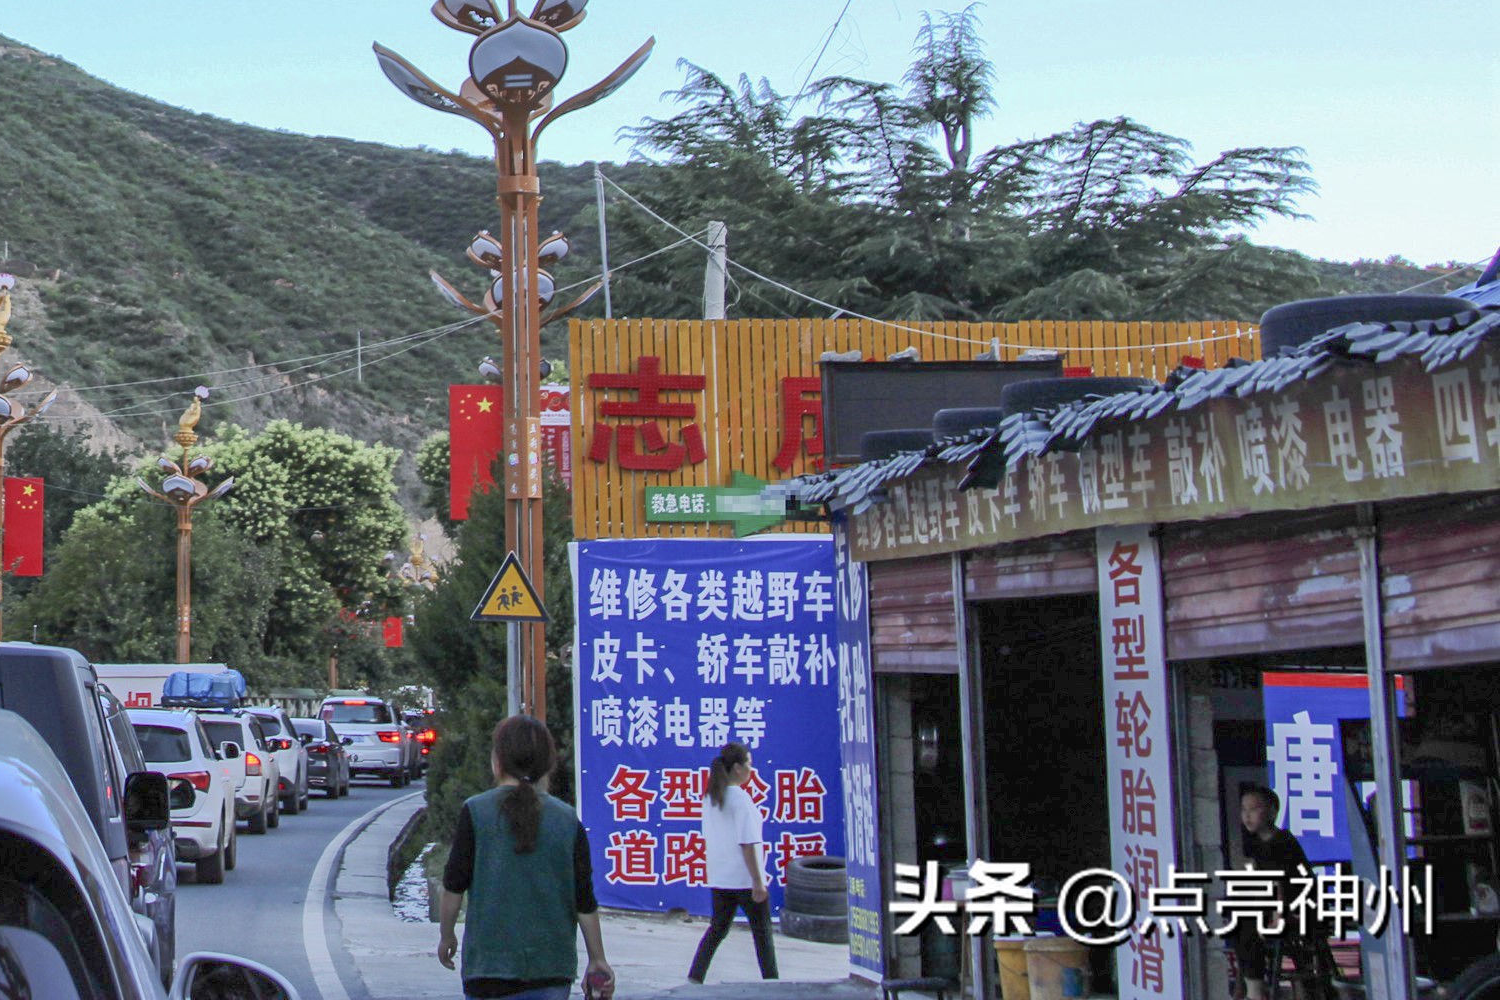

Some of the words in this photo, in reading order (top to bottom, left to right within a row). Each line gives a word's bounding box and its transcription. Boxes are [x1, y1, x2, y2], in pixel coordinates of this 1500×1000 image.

[1027, 452, 1068, 521] 轿车
[1079, 426, 1155, 515] 微型车
[1164, 412, 1228, 506] 敲补
[1235, 396, 1311, 496] 喷漆
[1323, 376, 1406, 482] 电器
[589, 567, 835, 622] 维修各类越野车
[838, 639, 867, 744] 轮胎
[590, 696, 767, 749] 喷漆电器等
[605, 831, 827, 887] 道路援
